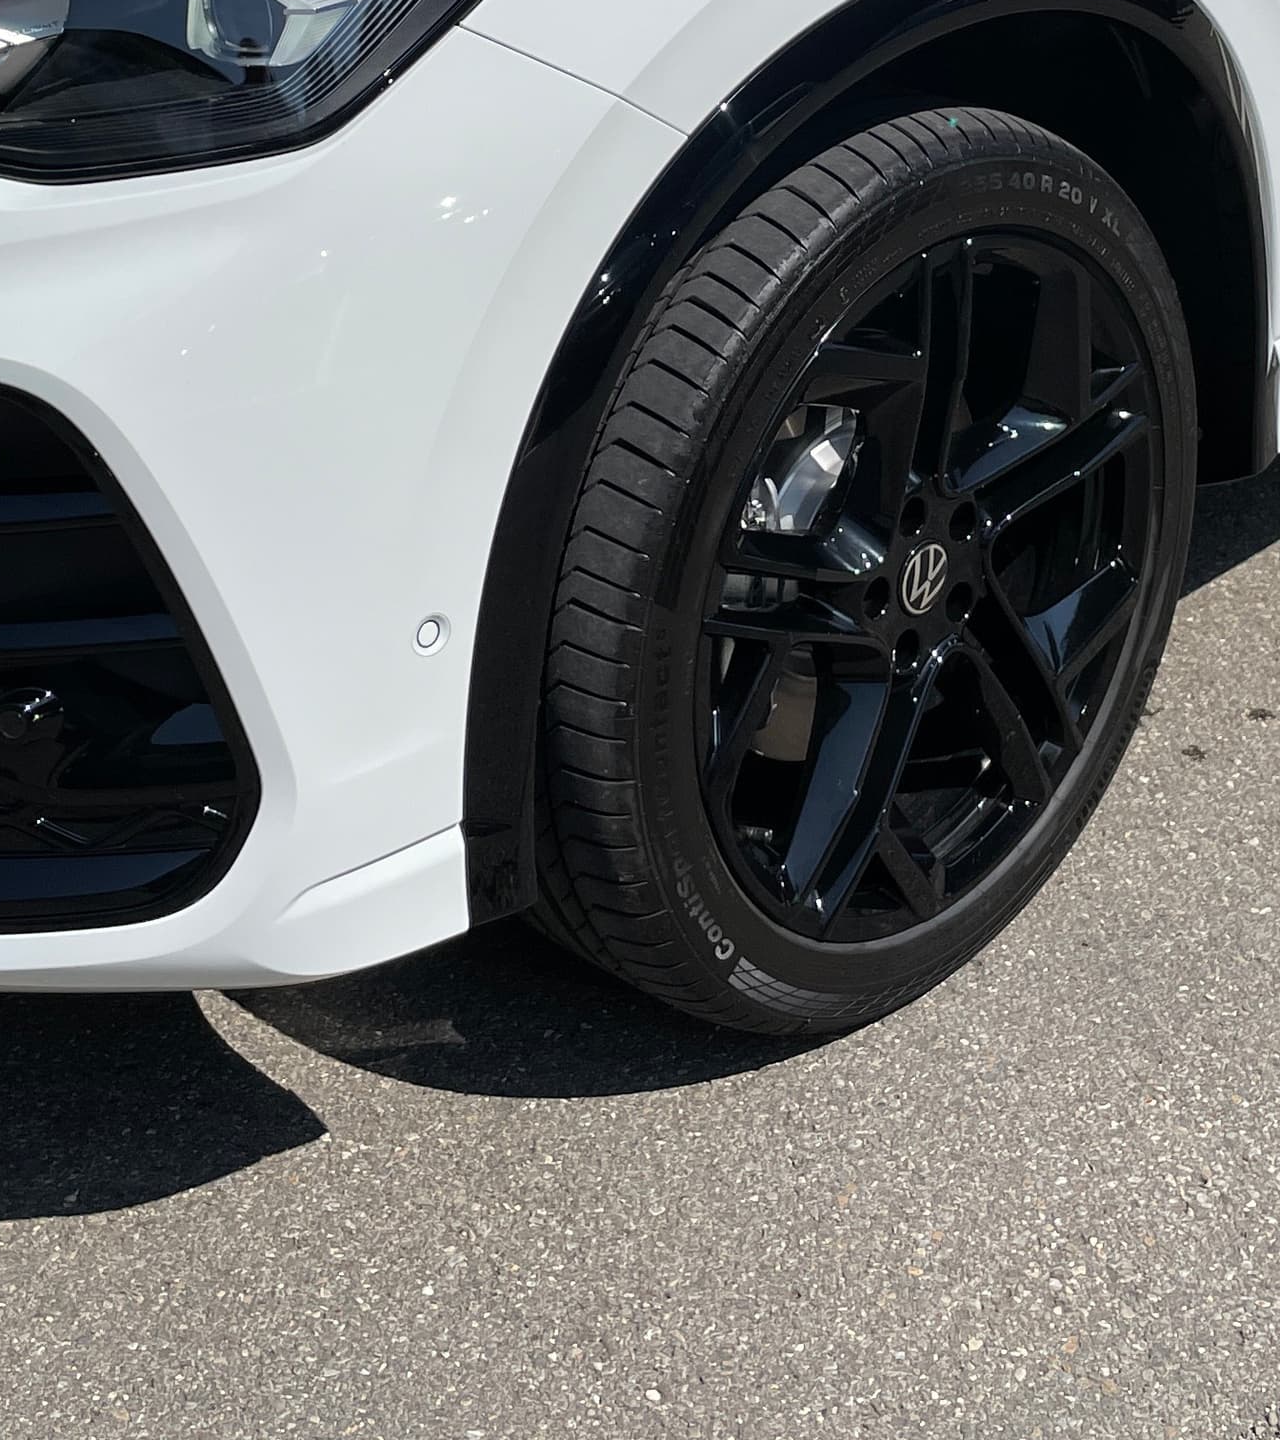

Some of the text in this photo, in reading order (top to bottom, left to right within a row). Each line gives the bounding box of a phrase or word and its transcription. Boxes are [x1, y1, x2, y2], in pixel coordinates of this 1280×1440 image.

[1008, 172, 1036, 191] 40
[1040, 174, 1054, 194] R
[1058, 180, 1083, 205] 20
[1089, 195, 1099, 214] V
[1101, 207, 1122, 238] XL
